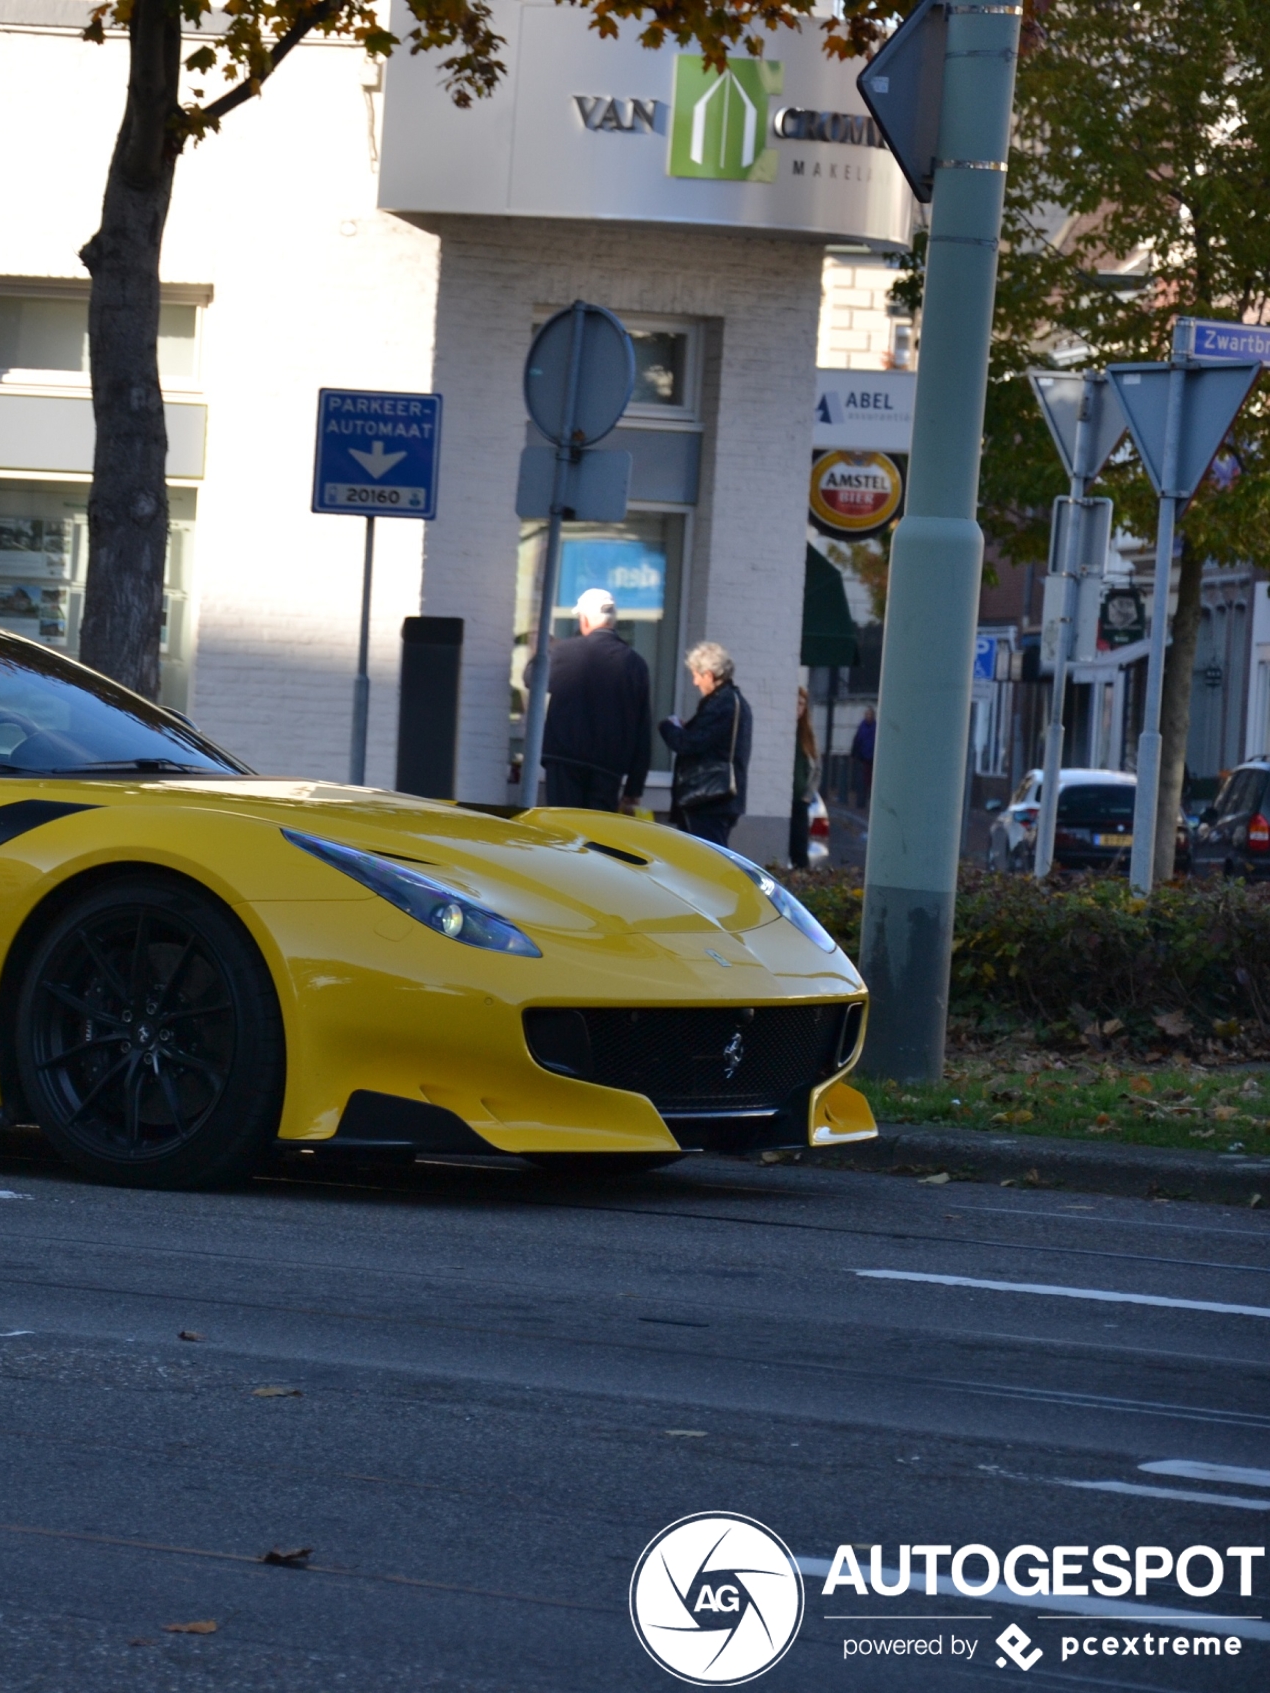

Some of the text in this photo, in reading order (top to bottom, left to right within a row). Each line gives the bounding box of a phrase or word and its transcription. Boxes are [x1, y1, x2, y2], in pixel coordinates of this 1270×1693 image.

[572, 94, 659, 132] VAN
[328, 397, 431, 416] PARKEER-
[846, 392, 894, 410] ABEL
[326, 419, 433, 438] AUTOMAAT
[826, 473, 889, 491] AMSTEL
[346, 488, 401, 505] 20160
[839, 491, 875, 505] BIER
